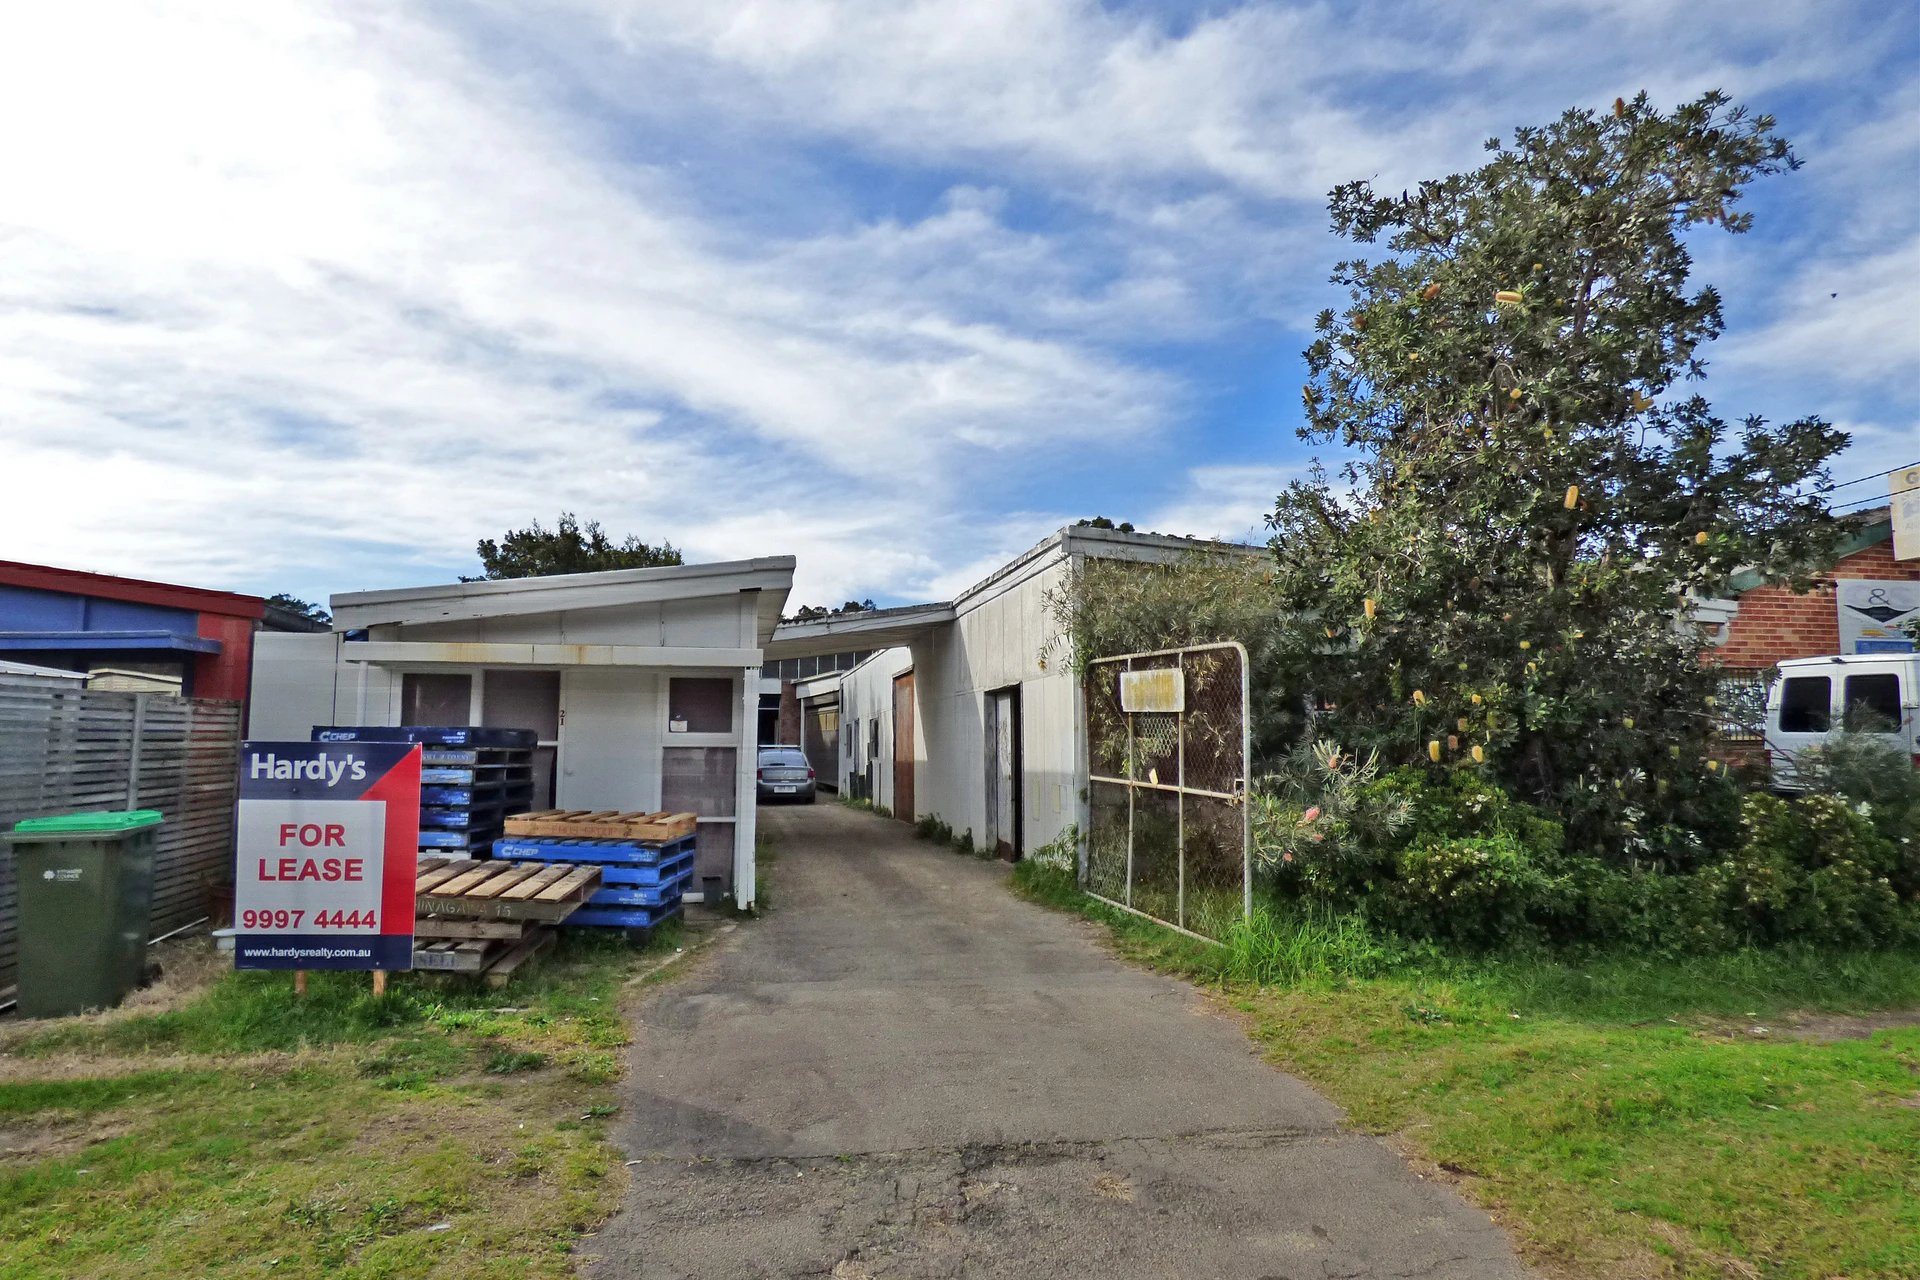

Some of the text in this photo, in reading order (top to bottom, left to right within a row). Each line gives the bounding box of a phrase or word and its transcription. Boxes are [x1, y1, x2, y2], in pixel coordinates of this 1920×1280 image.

[330, 732, 356, 741] CHEP
[251, 752, 367, 788] Hardy's
[279, 823, 346, 848] FOR
[512, 847, 539, 857] CHEP
[258, 858, 364, 882] LEASE
[243, 909, 377, 929] 9997 4444
[244, 947, 371, 959] www.hardysrealty.com.au
